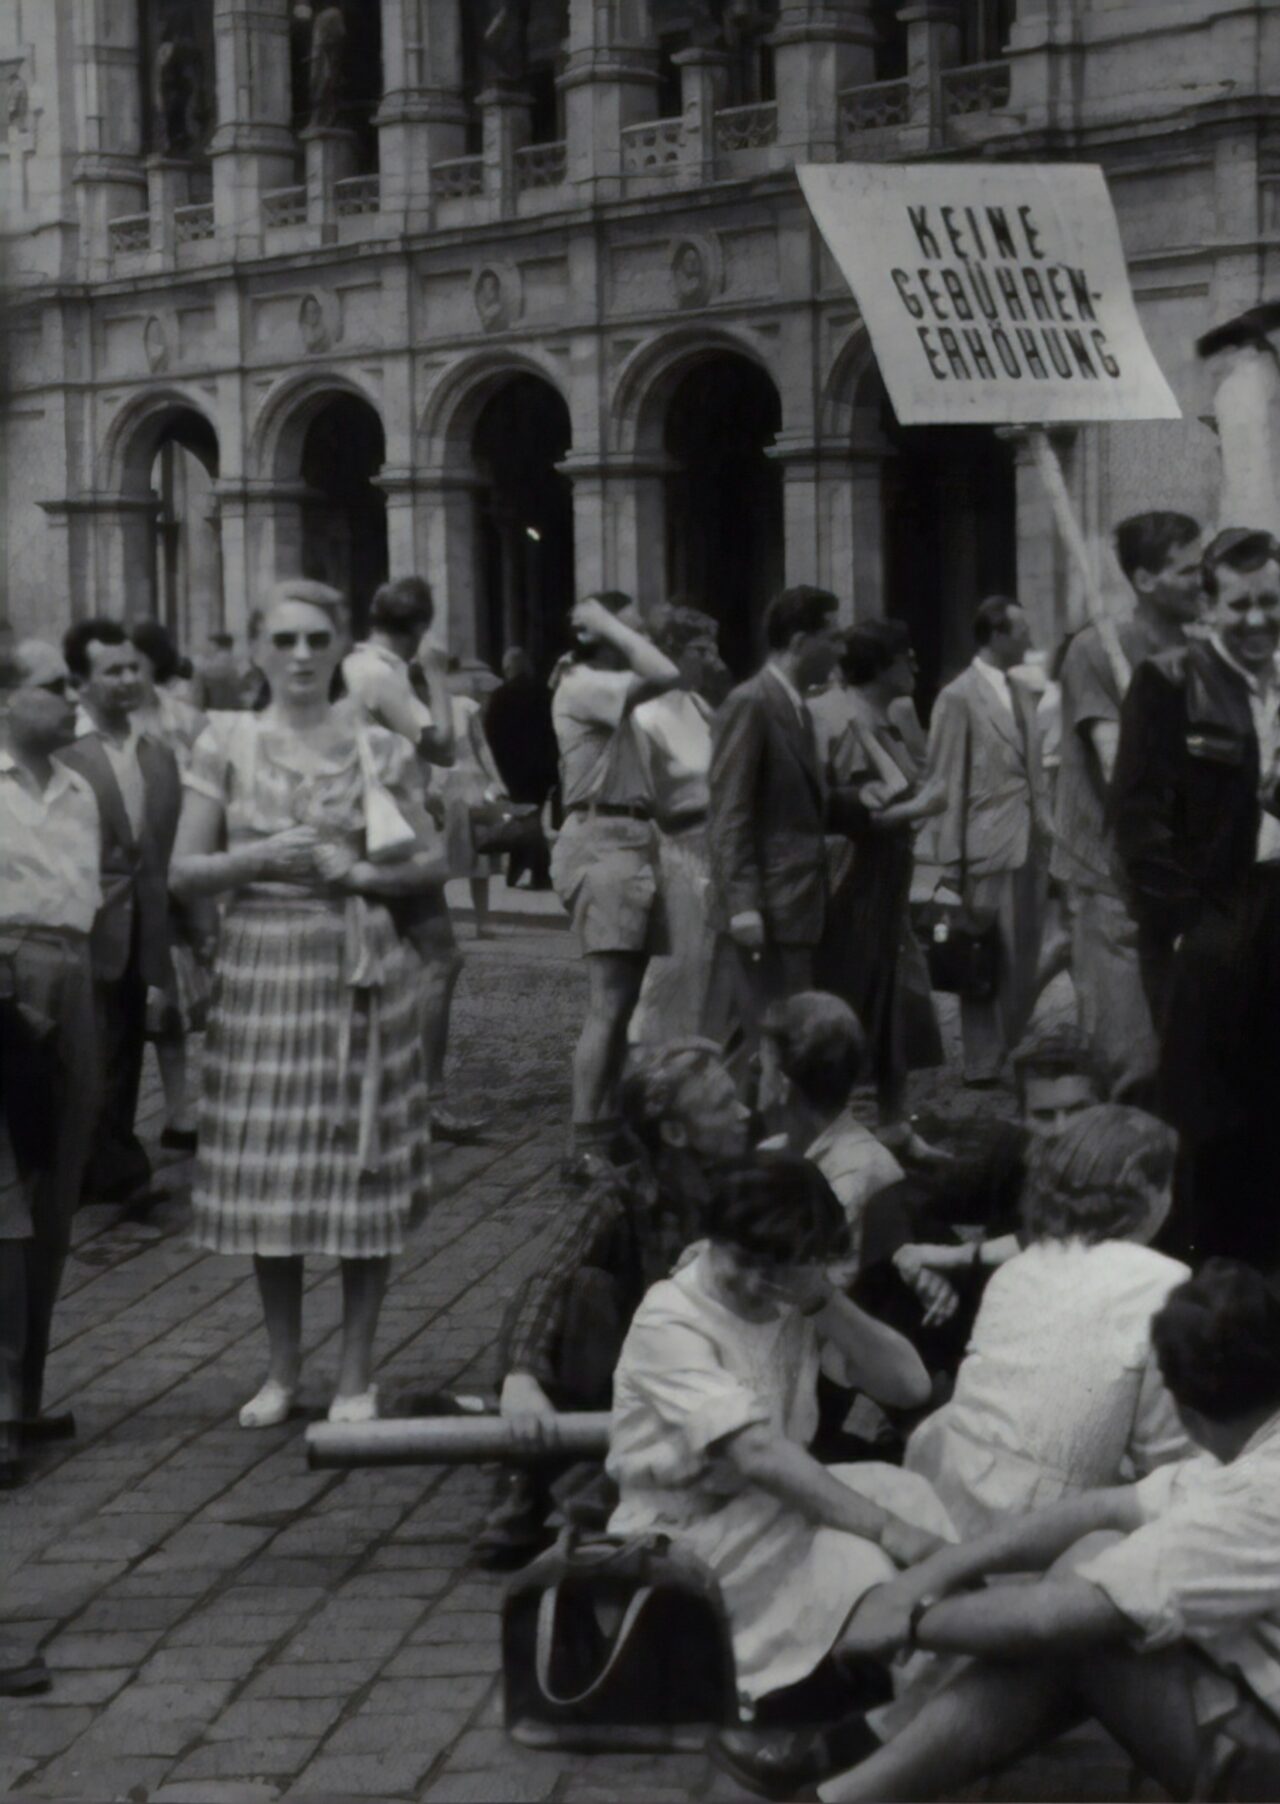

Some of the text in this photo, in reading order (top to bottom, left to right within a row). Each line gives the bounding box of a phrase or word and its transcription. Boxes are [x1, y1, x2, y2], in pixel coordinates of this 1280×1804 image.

[906, 205, 1045, 260] KEINE
[890, 259, 1103, 322] GEBÜHREN-
[916, 321, 1121, 381] ERHÖHUNG
